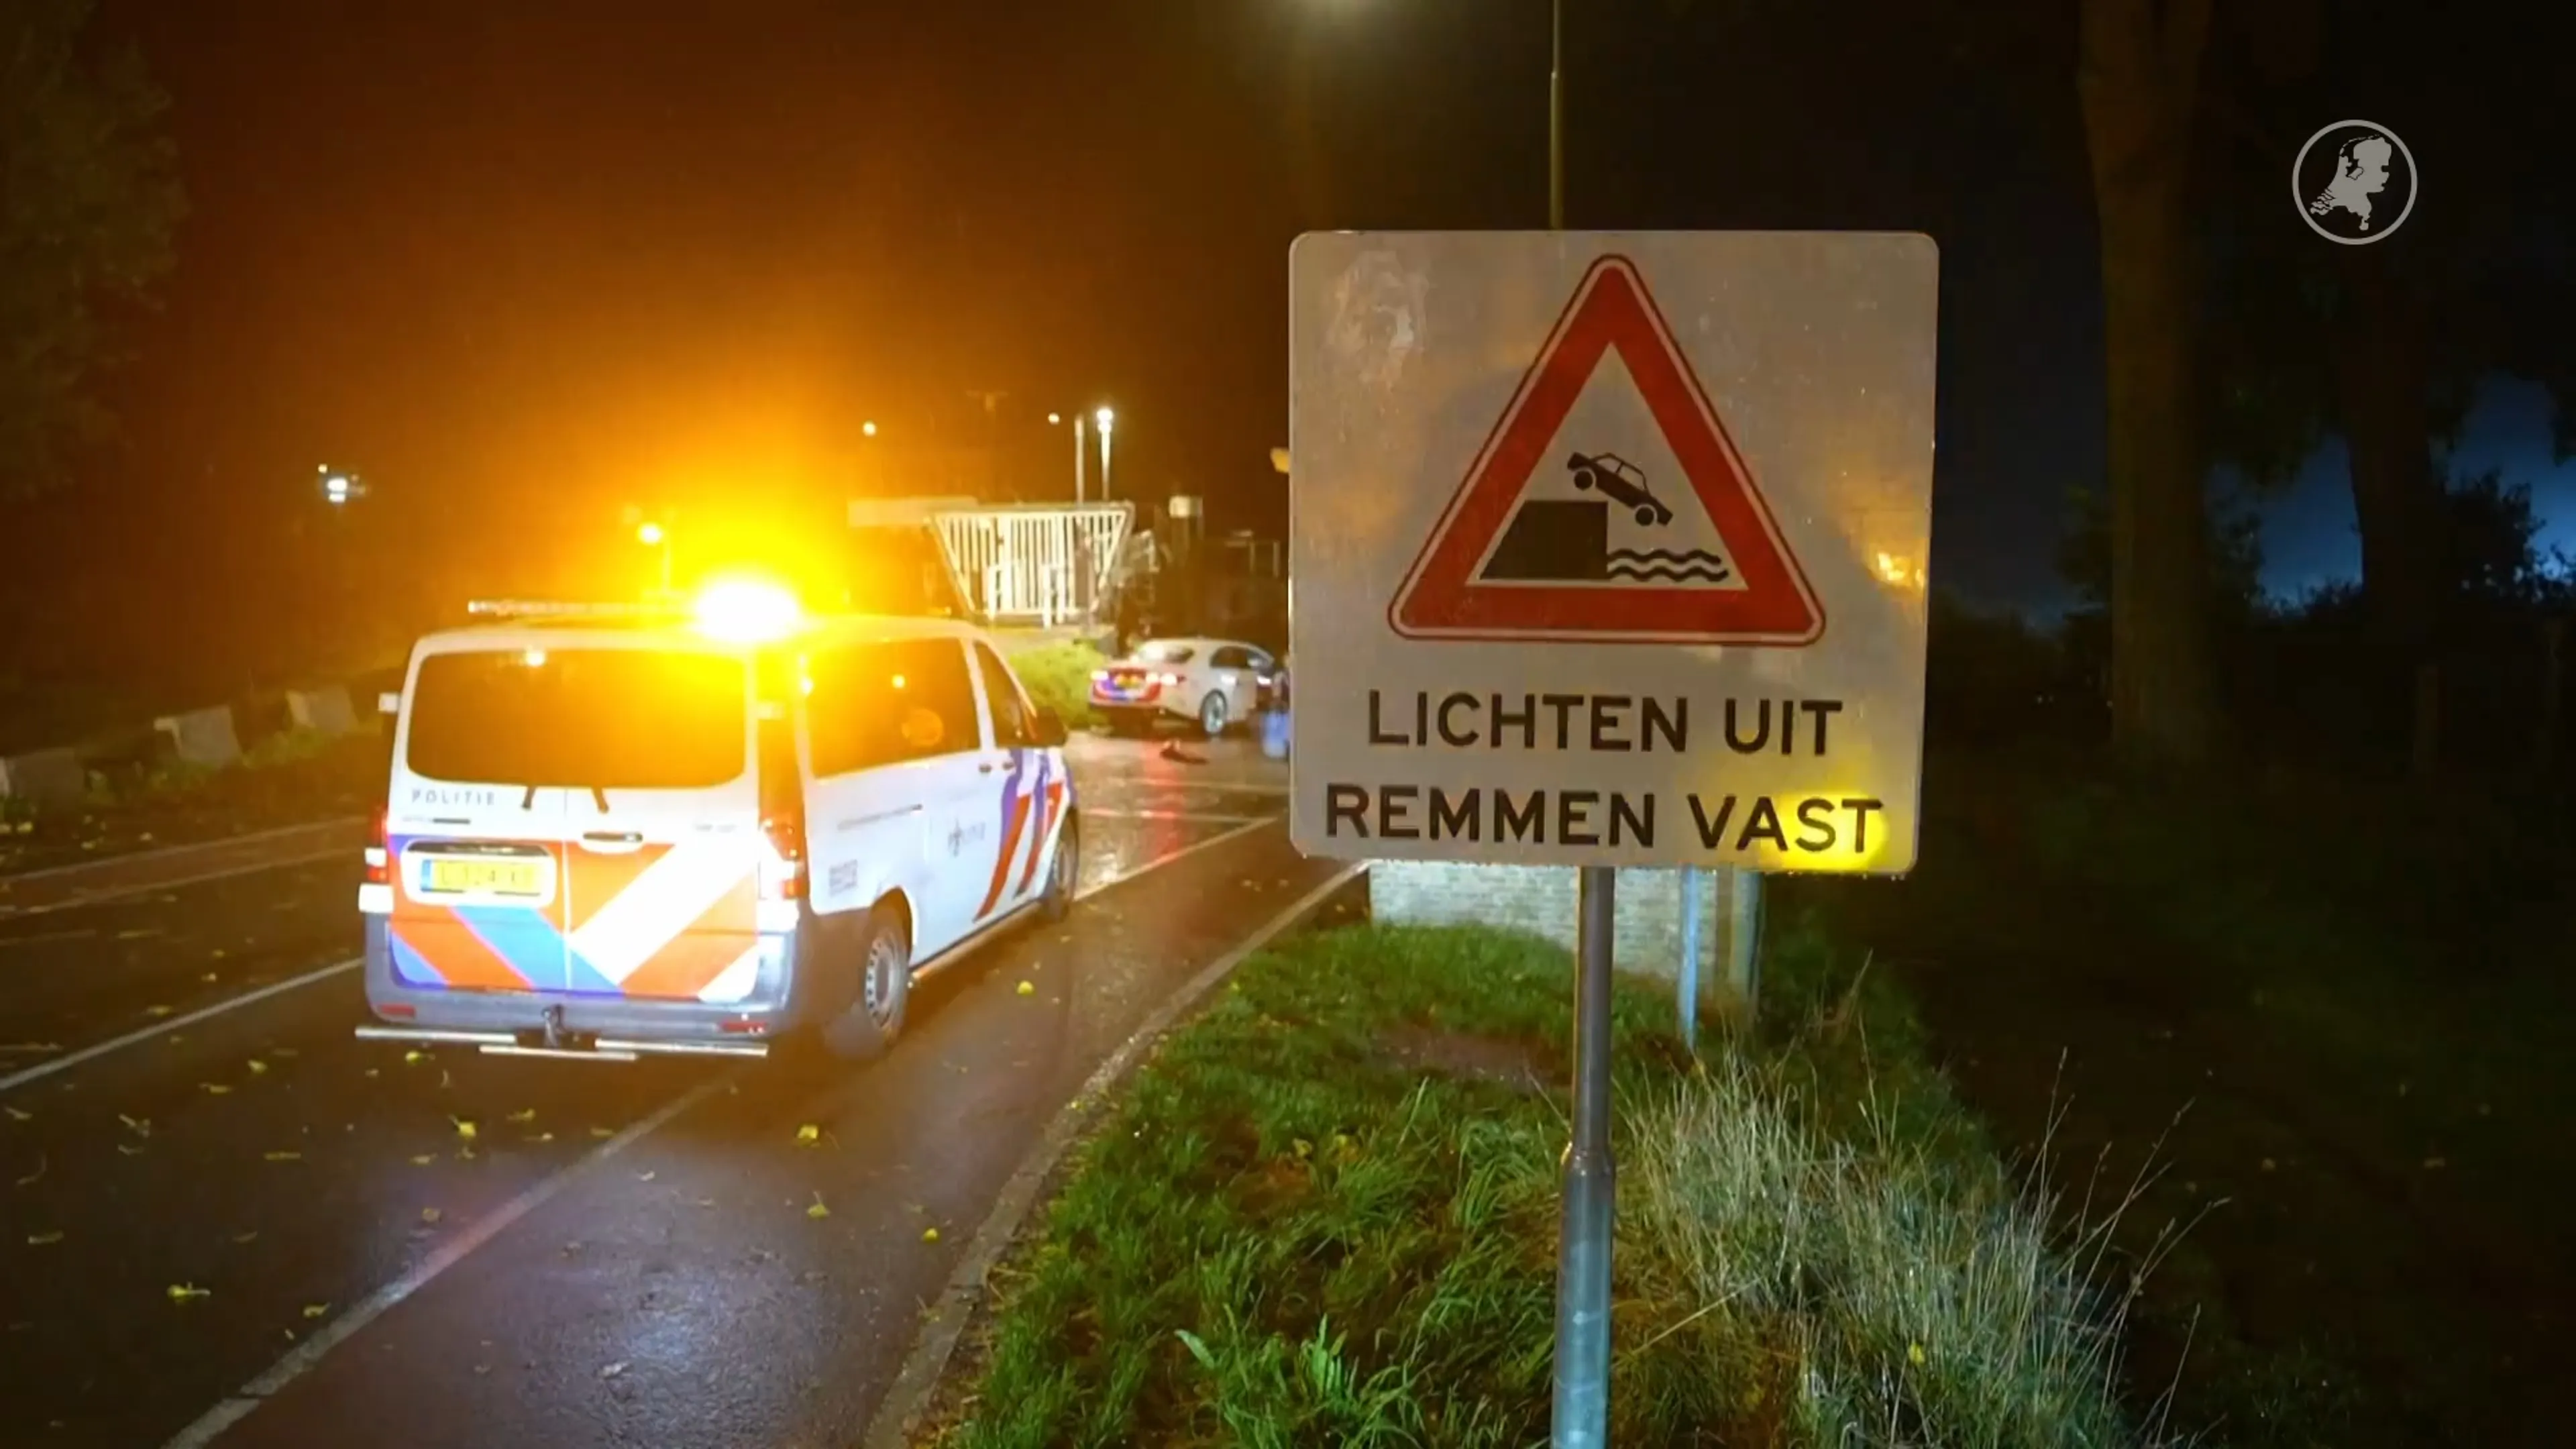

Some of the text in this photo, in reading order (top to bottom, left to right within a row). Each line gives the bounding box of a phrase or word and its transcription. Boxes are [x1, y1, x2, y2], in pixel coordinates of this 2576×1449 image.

[1368, 690, 1843, 755] LICHTEN UIT
[411, 788, 495, 807] POLITIE
[1326, 784, 1883, 853] REMMEN VAST
